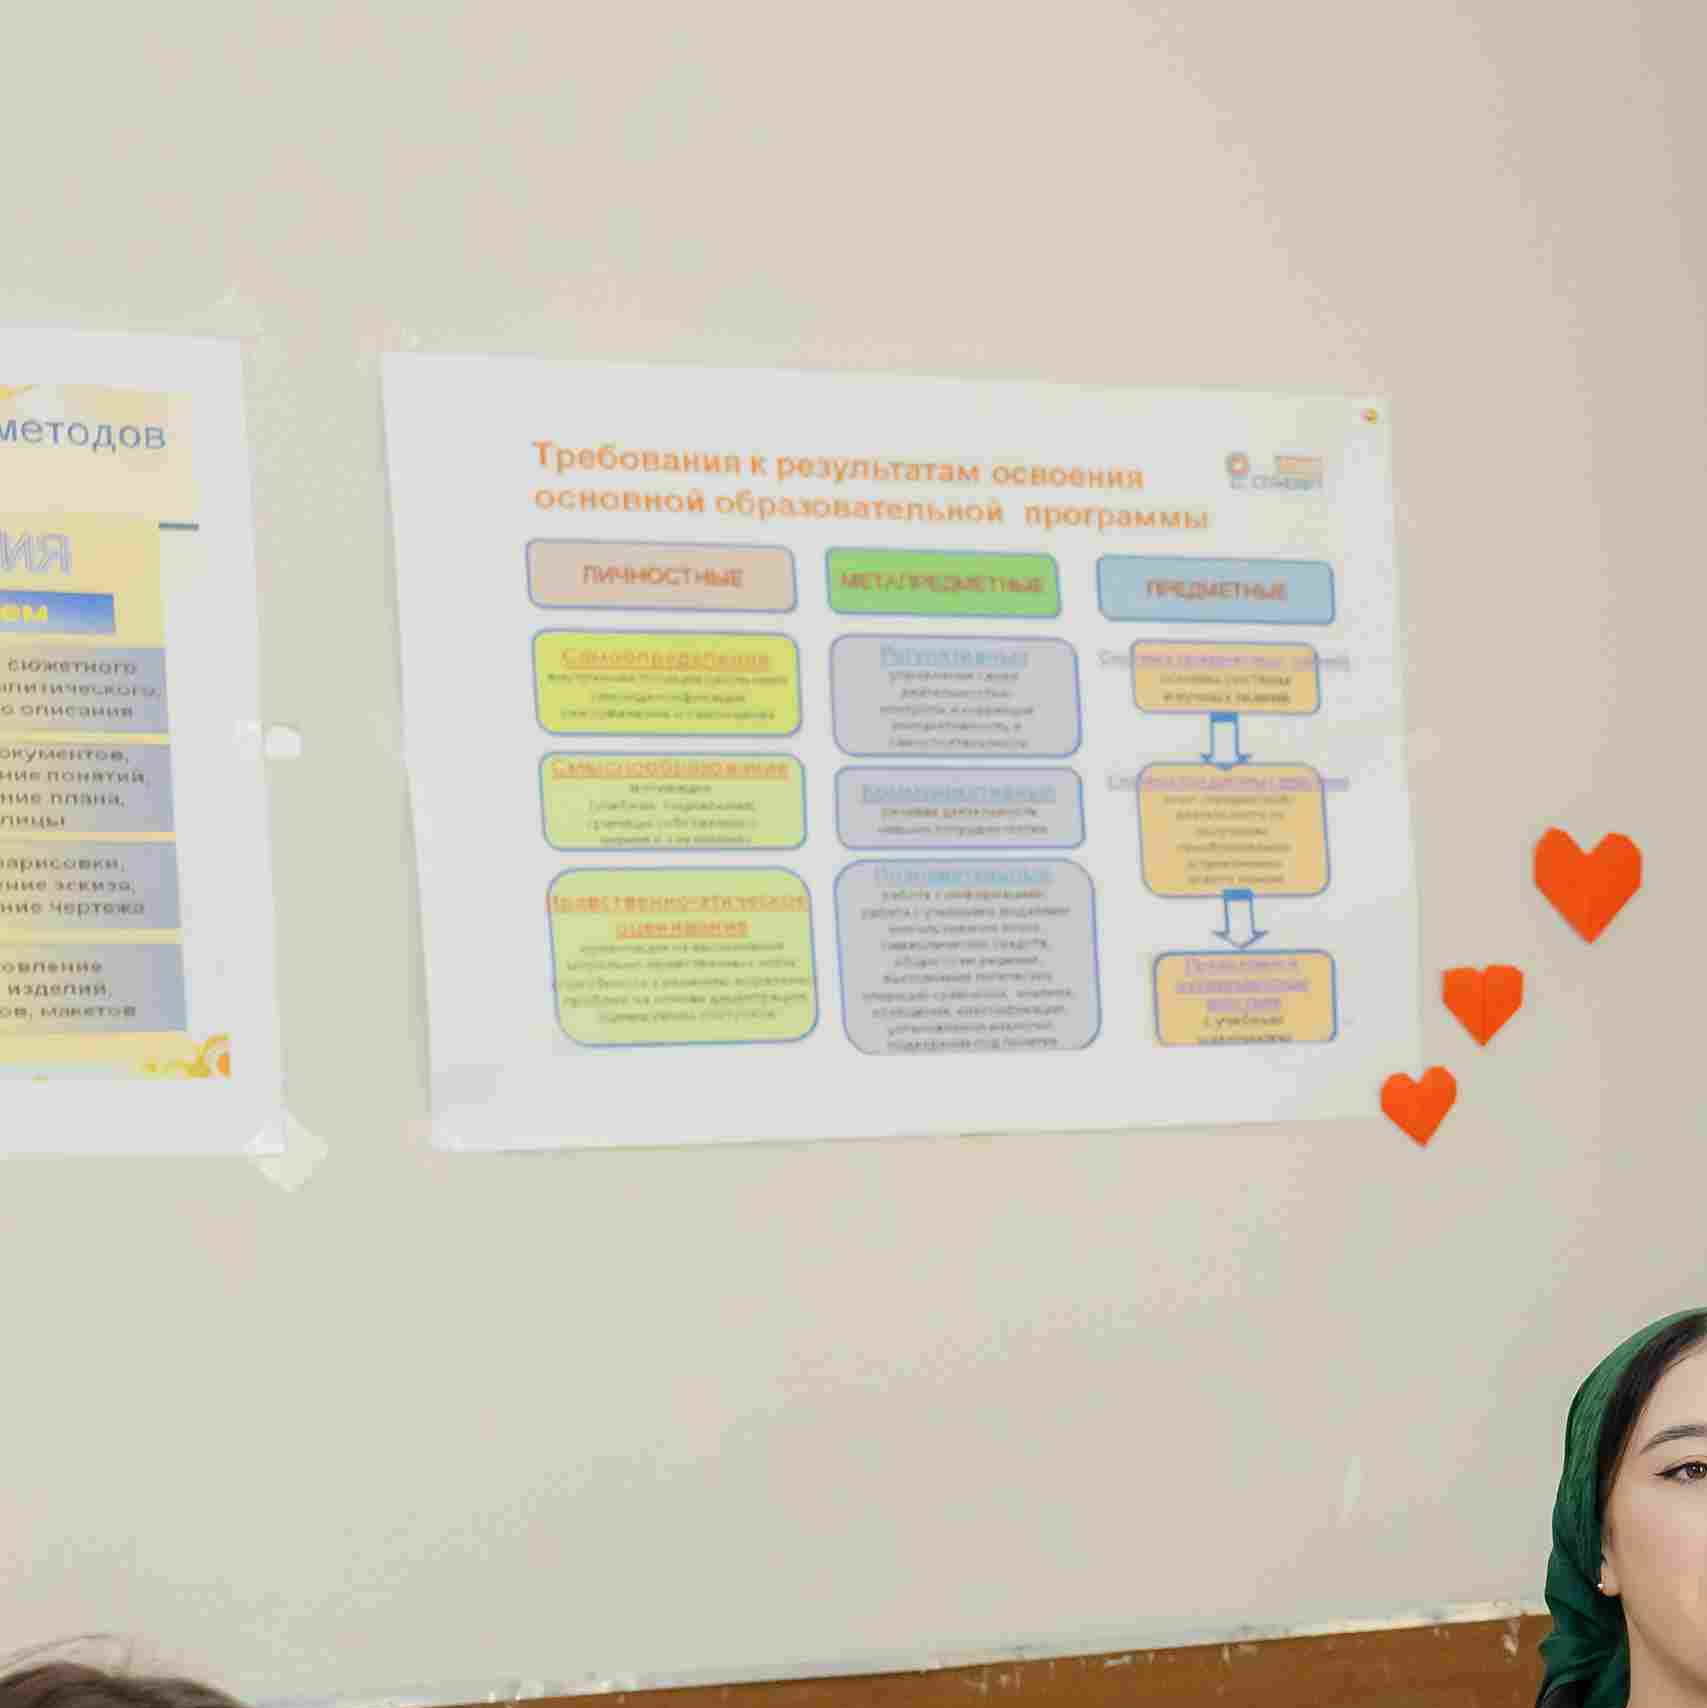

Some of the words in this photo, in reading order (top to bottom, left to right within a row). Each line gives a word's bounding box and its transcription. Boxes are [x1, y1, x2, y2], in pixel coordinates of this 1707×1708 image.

[532, 440, 741, 475] Требования
[750, 454, 769, 477] к
[775, 453, 981, 484] результатам
[992, 463, 1146, 489] освоения
[533, 489, 705, 514] основной
[714, 489, 1004, 525] образовательной
[1024, 502, 1211, 532] программы
[581, 564, 745, 588] ЛИЧНОСТНЫЕ
[840, 571, 1045, 595] МЕТАПРЕДМЕТНЫЕ
[1146, 577, 1288, 602] ПРЕДМЕТНЫЕ
[20, 702, 134, 720] описания
